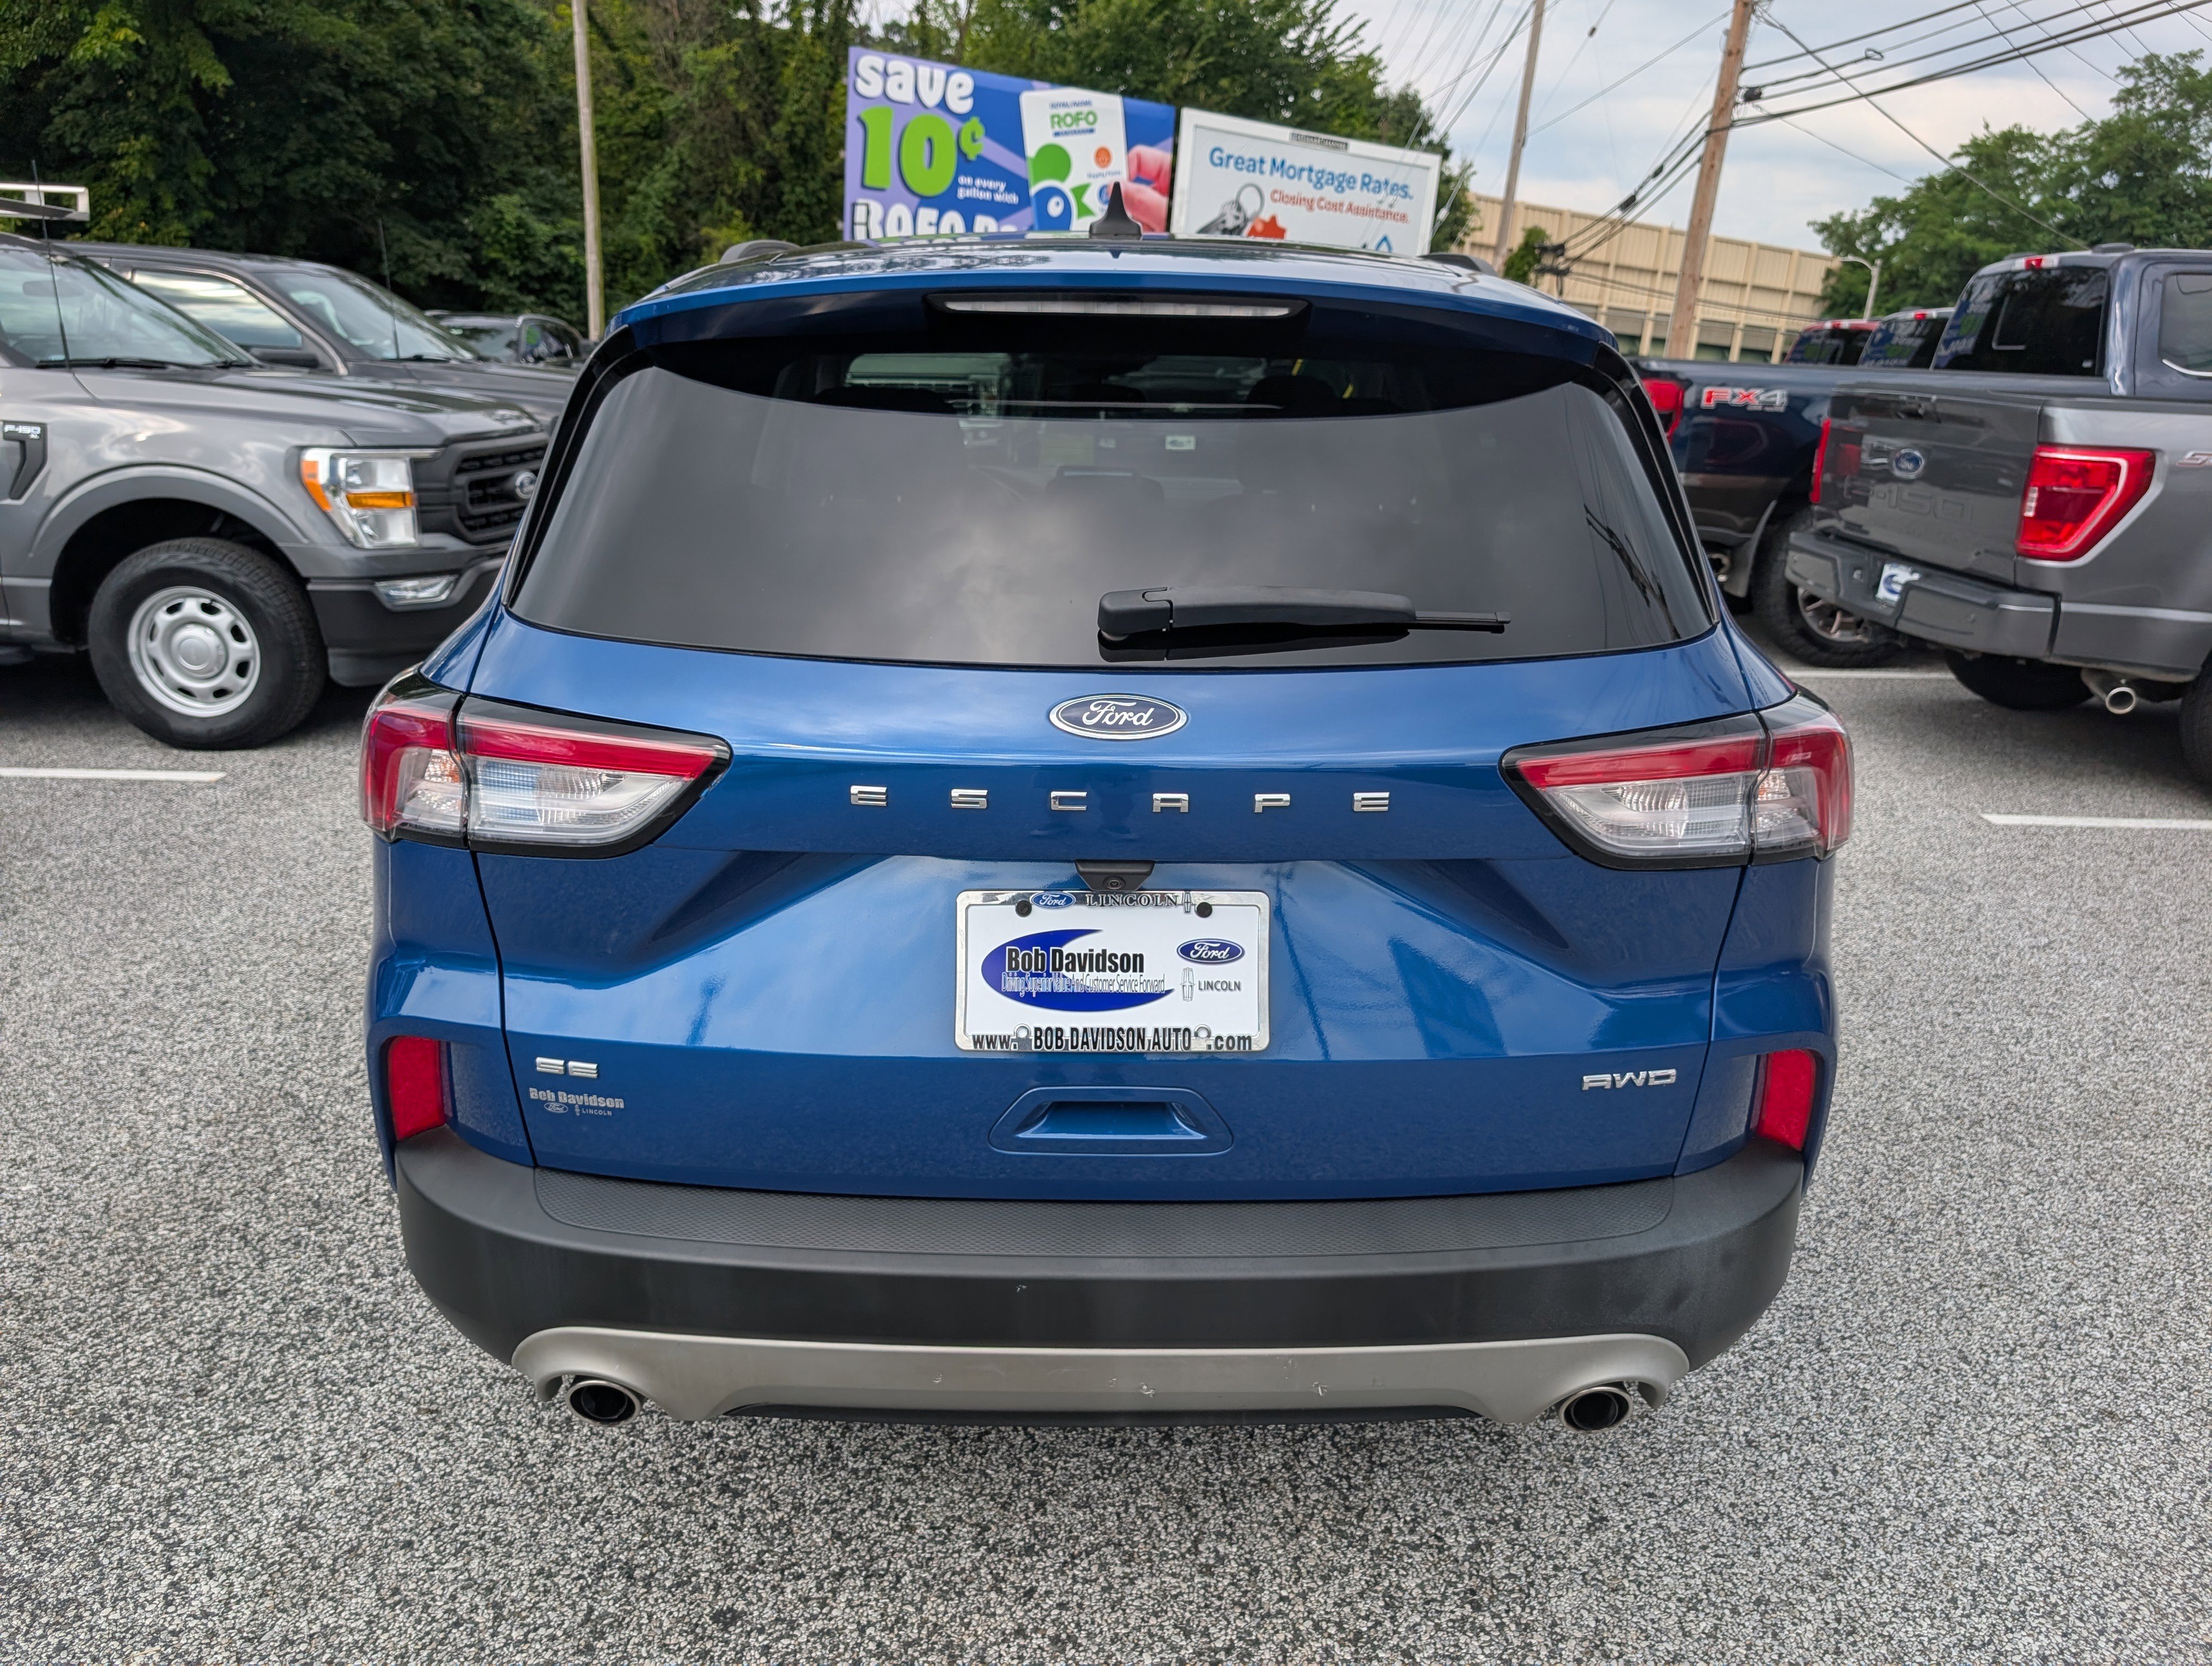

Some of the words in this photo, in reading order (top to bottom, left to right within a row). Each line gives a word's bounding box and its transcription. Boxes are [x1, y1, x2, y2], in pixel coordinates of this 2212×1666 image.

[1049, 110, 1098, 129] ROFO
[958, 176, 973, 185] on
[974, 177, 1006, 192] every
[1209, 146, 1266, 175] Great
[1270, 156, 1355, 194] Mortgage
[1360, 173, 1413, 200] Rates.
[1270, 189, 1314, 212] Closing
[1316, 196, 1343, 212] Cost
[1700, 386, 1788, 409] FX4
[1082, 700, 1155, 726] Ford
[850, 785, 1390, 813] ESCAPE
[1039, 893, 1067, 907] Ford
[1085, 894, 1179, 907] LINCOLN
[1007, 947, 1046, 973] Bob
[1051, 947, 1144, 973] Davidson
[1191, 942, 1230, 959] Ford
[1002, 972, 1025, 997] Driving
[1025, 973, 1053, 997] Superior
[1053, 973, 1070, 992] Value
[1071, 973, 1084, 992] And
[1085, 973, 1116, 993] Customer
[1117, 974, 1138, 993] Service
[1139, 973, 1165, 993] Forward
[1198, 980, 1242, 991] LINCOLN
[1033, 1027, 1064, 1050] BOB
[1070, 1027, 1146, 1050] DAVIDSON
[1152, 1027, 1192, 1050] AUTO
[536, 1057, 599, 1079] SE
[1582, 1068, 1676, 1091] AWD
[529, 1087, 556, 1101] Bob
[558, 1091, 625, 1108] Davidson
[582, 1108, 612, 1117] LINCOLN
